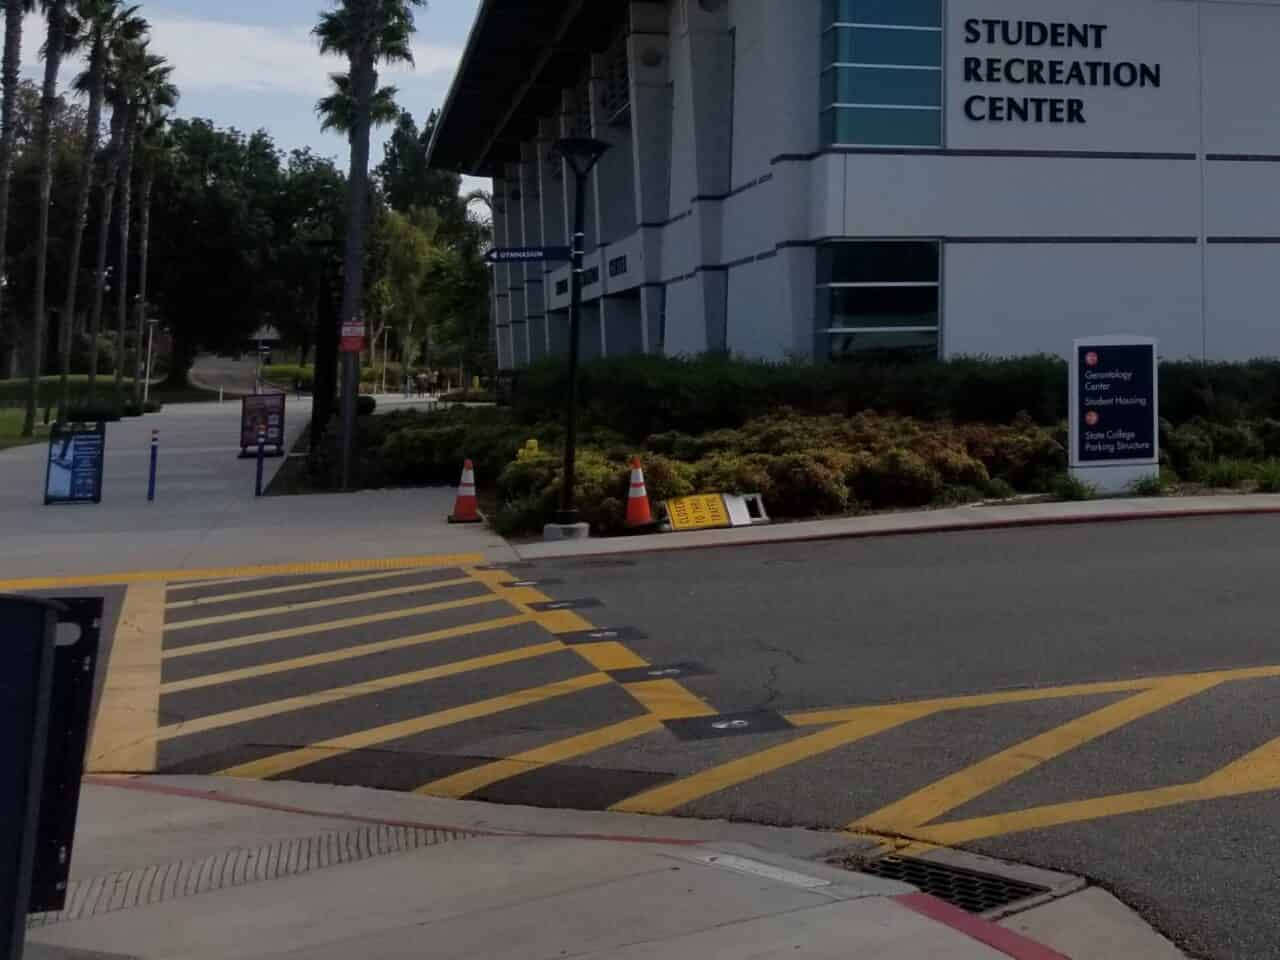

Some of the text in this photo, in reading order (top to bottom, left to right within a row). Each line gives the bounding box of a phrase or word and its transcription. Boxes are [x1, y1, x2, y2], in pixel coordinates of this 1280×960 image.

[964, 18, 1107, 49] STUDENT
[963, 56, 1161, 88] RECREATION
[963, 95, 1087, 124] CENTER
[1084, 369, 1133, 381] Gerontology
[1084, 382, 1112, 391] Center
[1084, 395, 1147, 407] Student Housing
[1085, 428, 1136, 440] State College
[1085, 441, 1150, 453] Parking Structure
